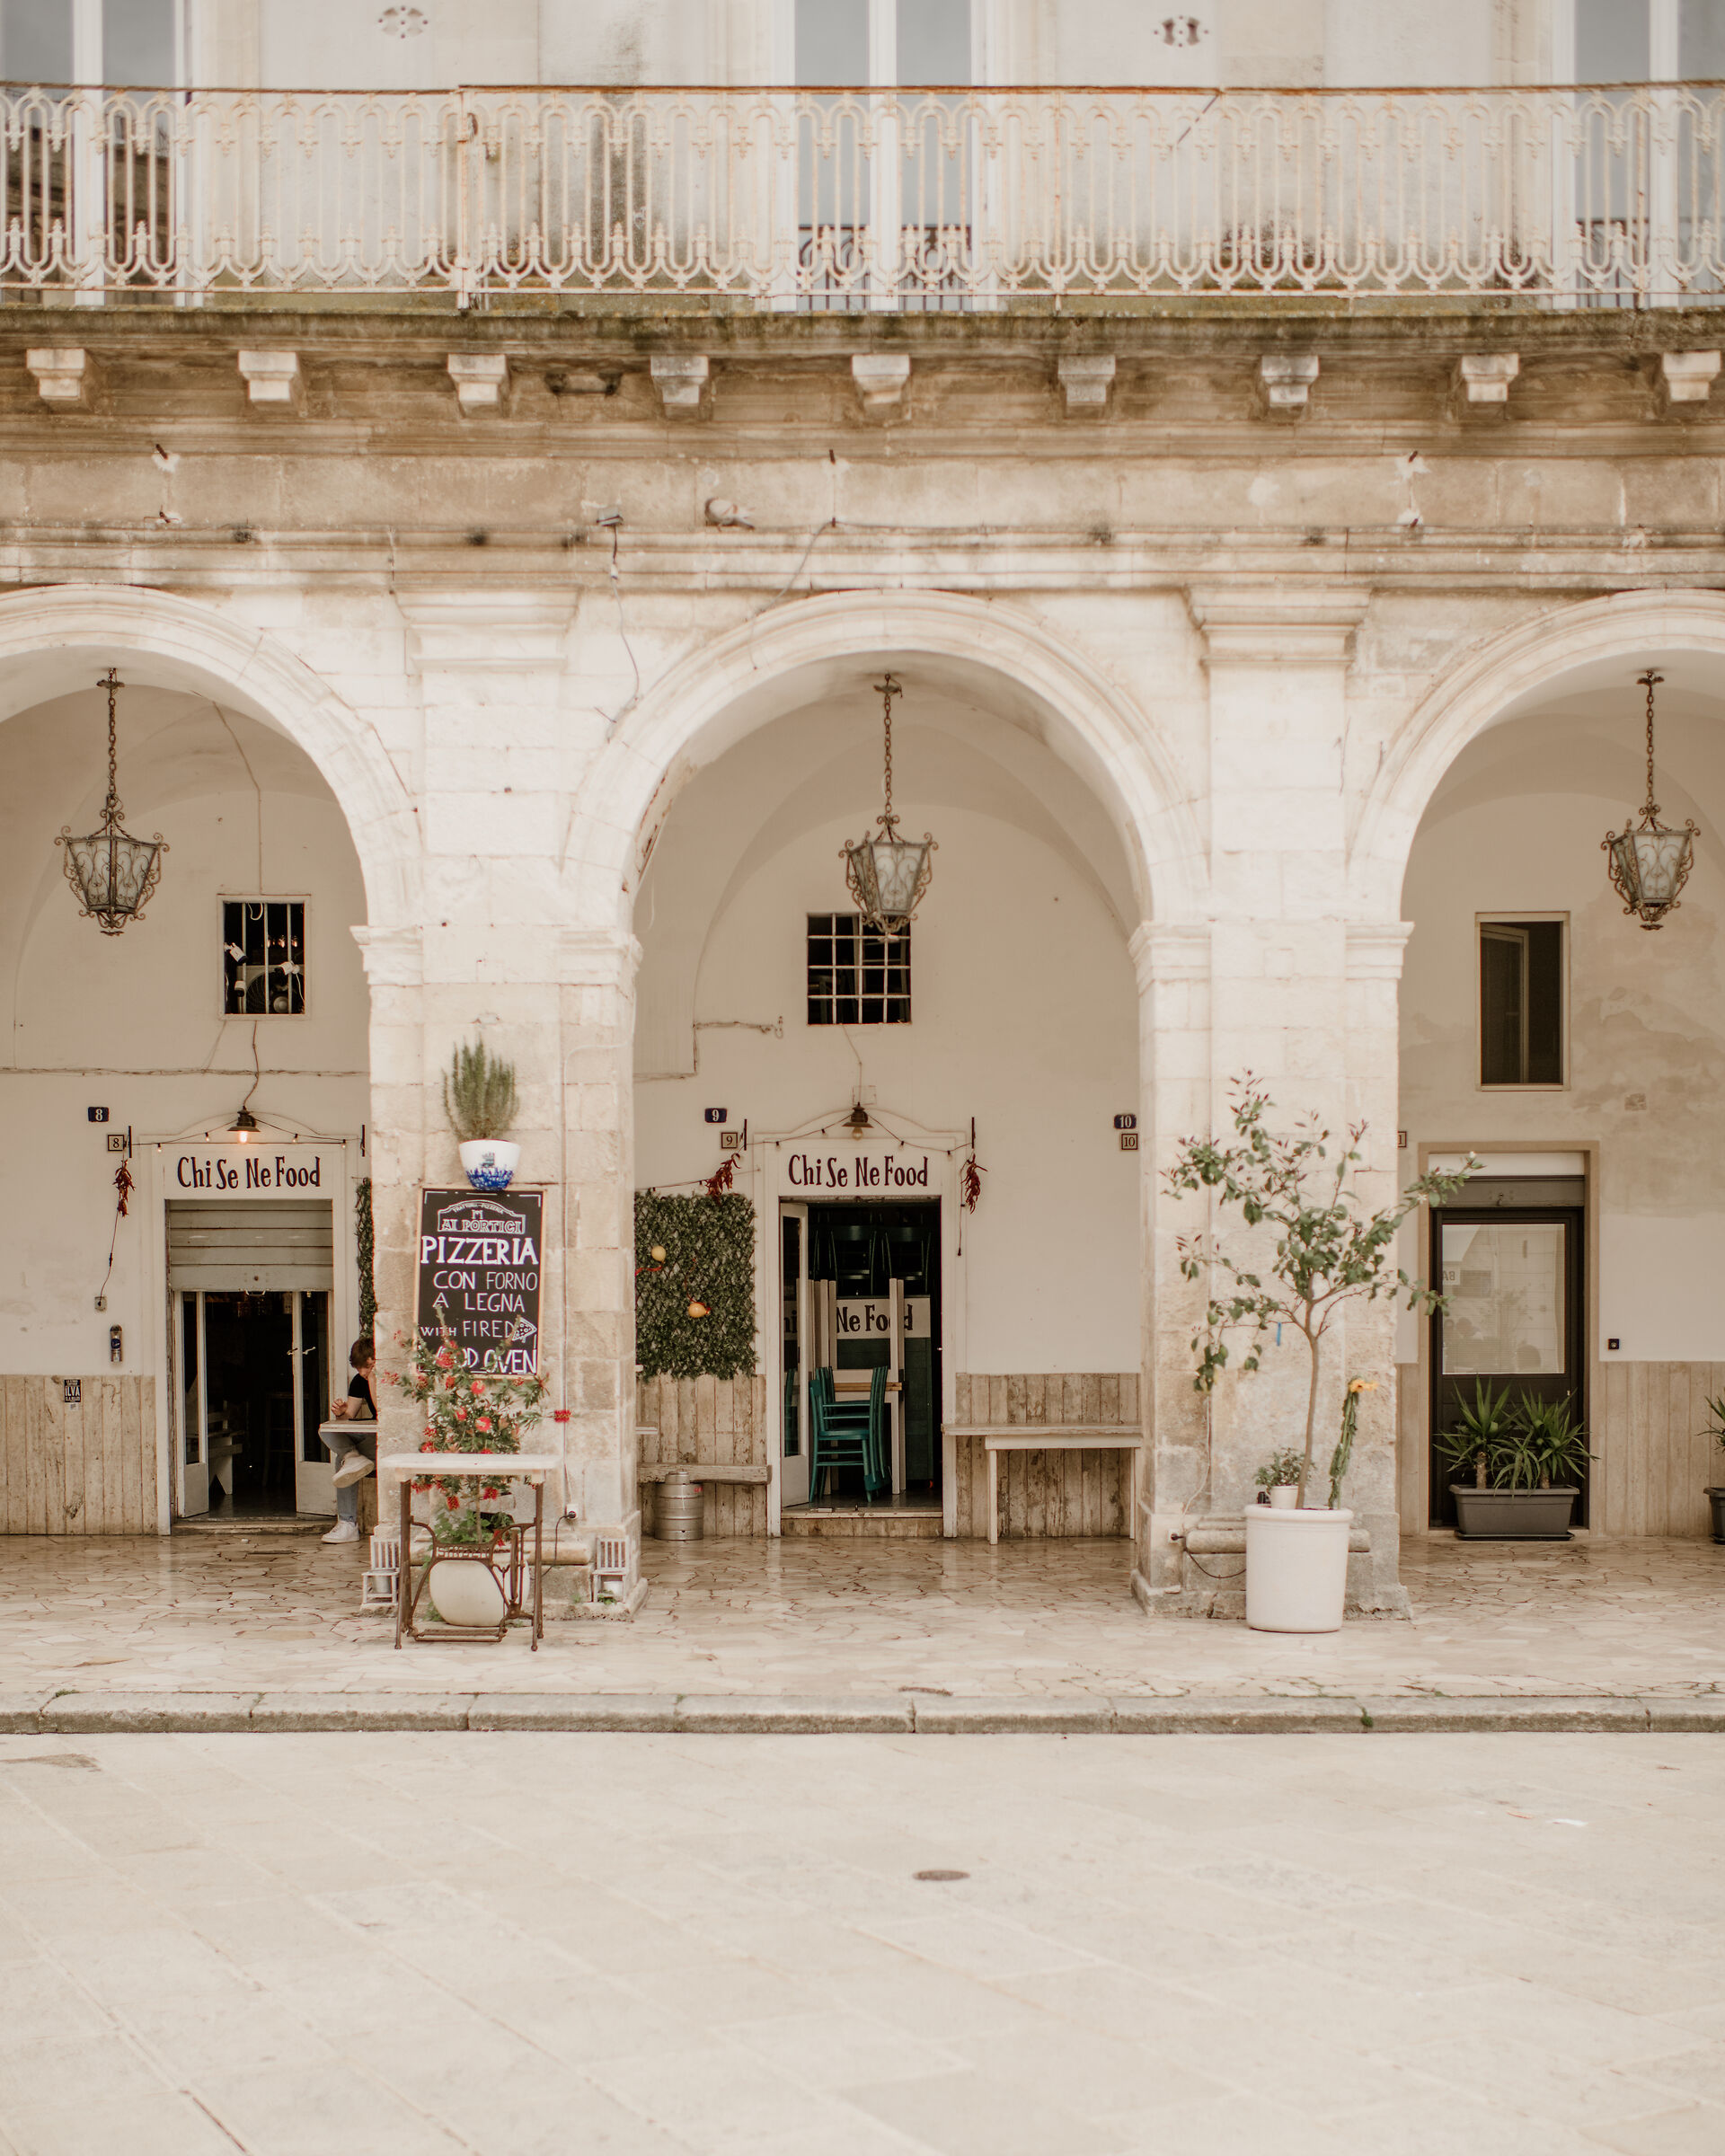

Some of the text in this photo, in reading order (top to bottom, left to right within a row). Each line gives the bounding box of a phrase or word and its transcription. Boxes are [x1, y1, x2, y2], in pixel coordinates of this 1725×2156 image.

[95, 1109, 103, 1121] 8
[712, 1109, 720, 1121] 9
[1119, 1115, 1132, 1128] 10
[112, 1138, 119, 1148] 8
[726, 1135, 733, 1145] 9
[1124, 1136, 1136, 1147] 10
[177, 1155, 321, 1189] Chi Se Ne Food
[788, 1154, 928, 1188] Chi Se Ne Food
[462, 1219, 522, 1234] PORTICI
[420, 1235, 539, 1265] PIZZERIA
[433, 1270, 538, 1291] CON FORNO
[432, 1292, 526, 1312] A LEGNA
[836, 1304, 914, 1333] Ne Fod
[420, 1320, 515, 1339] WITH FIRED
[483, 1349, 537, 1374] OVEN
[65, 1386, 81, 1397] ILVA
